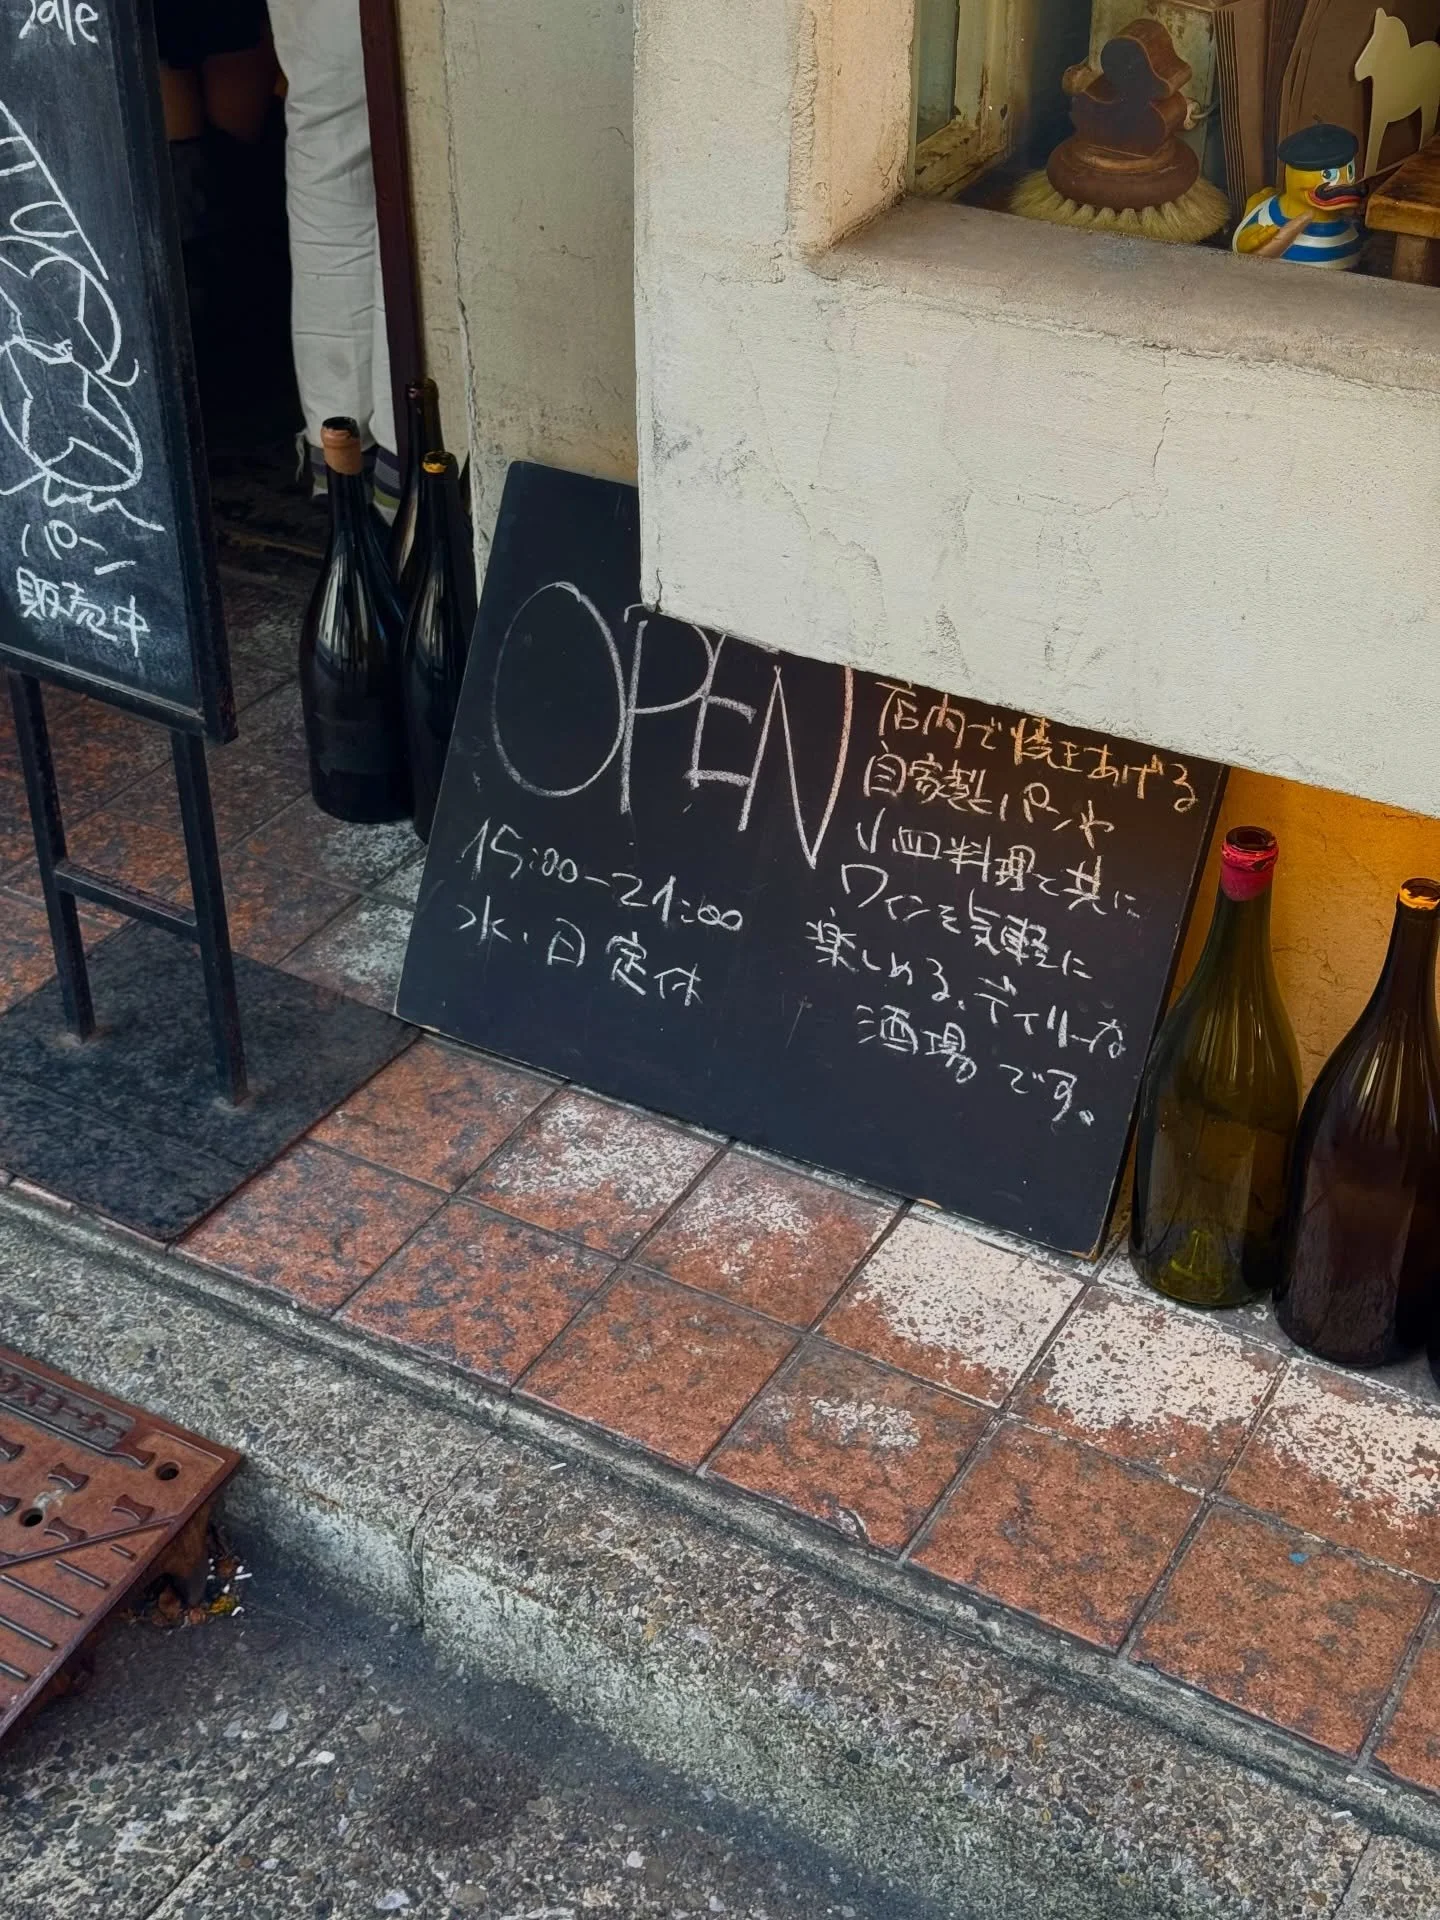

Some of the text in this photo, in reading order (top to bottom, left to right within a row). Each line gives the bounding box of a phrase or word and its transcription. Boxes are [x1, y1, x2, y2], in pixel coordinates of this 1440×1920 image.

[15, 565, 151, 658] 販売中
[491, 580, 855, 870] OPEN
[862, 740, 1115, 850] 自家製パンや
[841, 863, 1093, 979] ワインを気軽に
